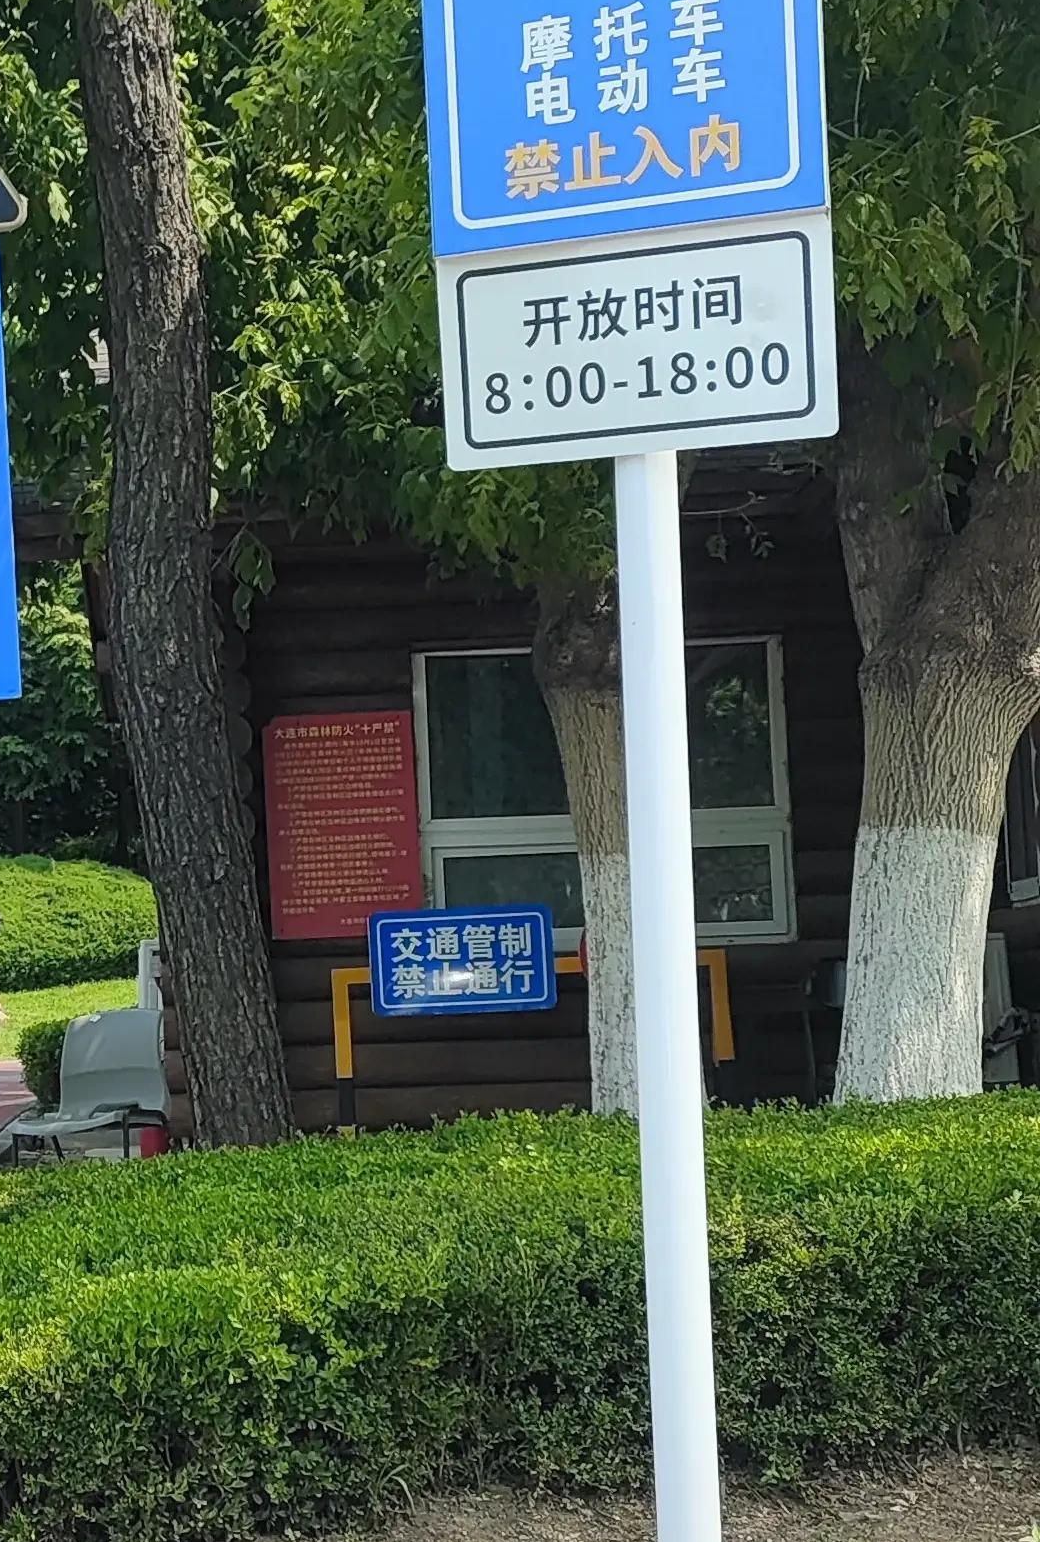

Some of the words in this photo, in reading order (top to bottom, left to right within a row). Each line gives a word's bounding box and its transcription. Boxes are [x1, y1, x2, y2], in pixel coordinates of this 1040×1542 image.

[525, 48, 727, 126] 电动车
[504, 115, 741, 200] 禁止入内
[522, 276, 742, 348] 开放时间
[483, 342, 791, 416] 8:00-18:00
[390, 923, 533, 962] 交通管制
[391, 959, 535, 999] 禁止通行
